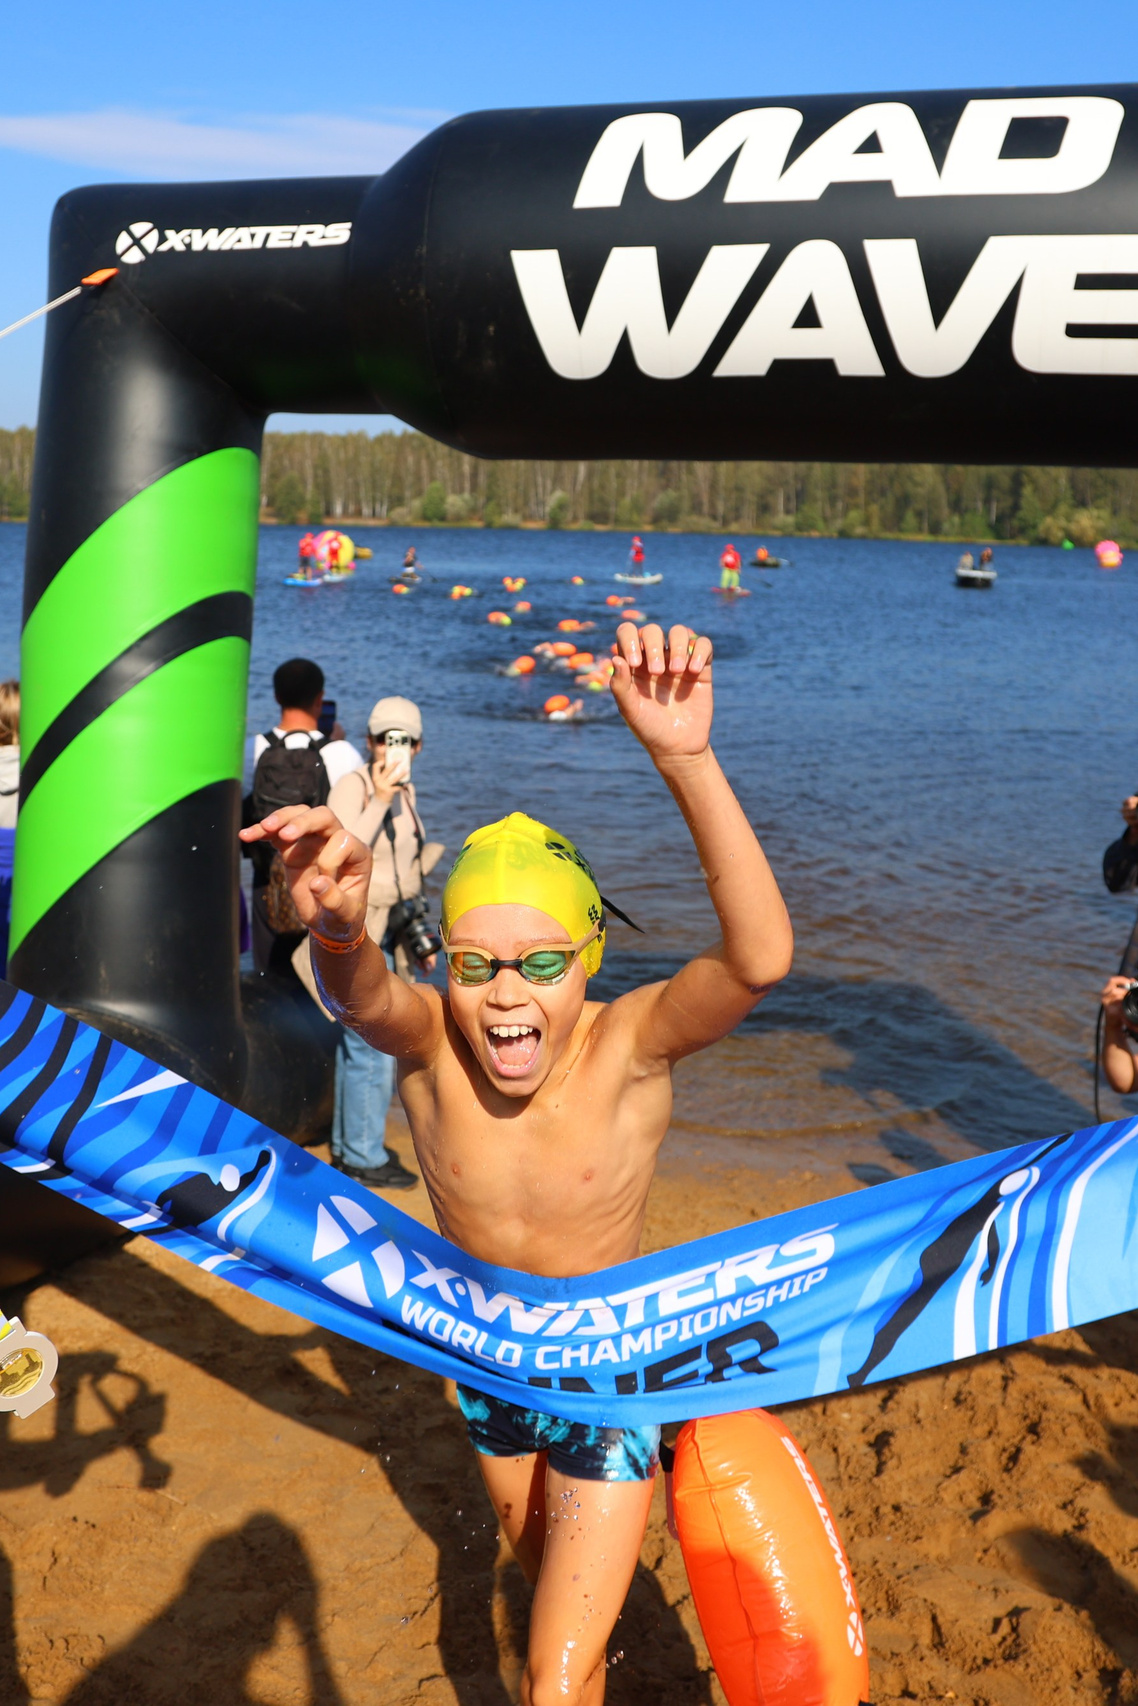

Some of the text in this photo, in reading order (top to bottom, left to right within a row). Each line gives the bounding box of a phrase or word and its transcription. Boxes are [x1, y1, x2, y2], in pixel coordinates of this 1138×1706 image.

[573, 96, 1125, 209] MAD
[511, 234, 1138, 379] WAVE
[401, 1294, 523, 1368] WORLD
[534, 1267, 828, 1370] CHAMPIONSHIP
